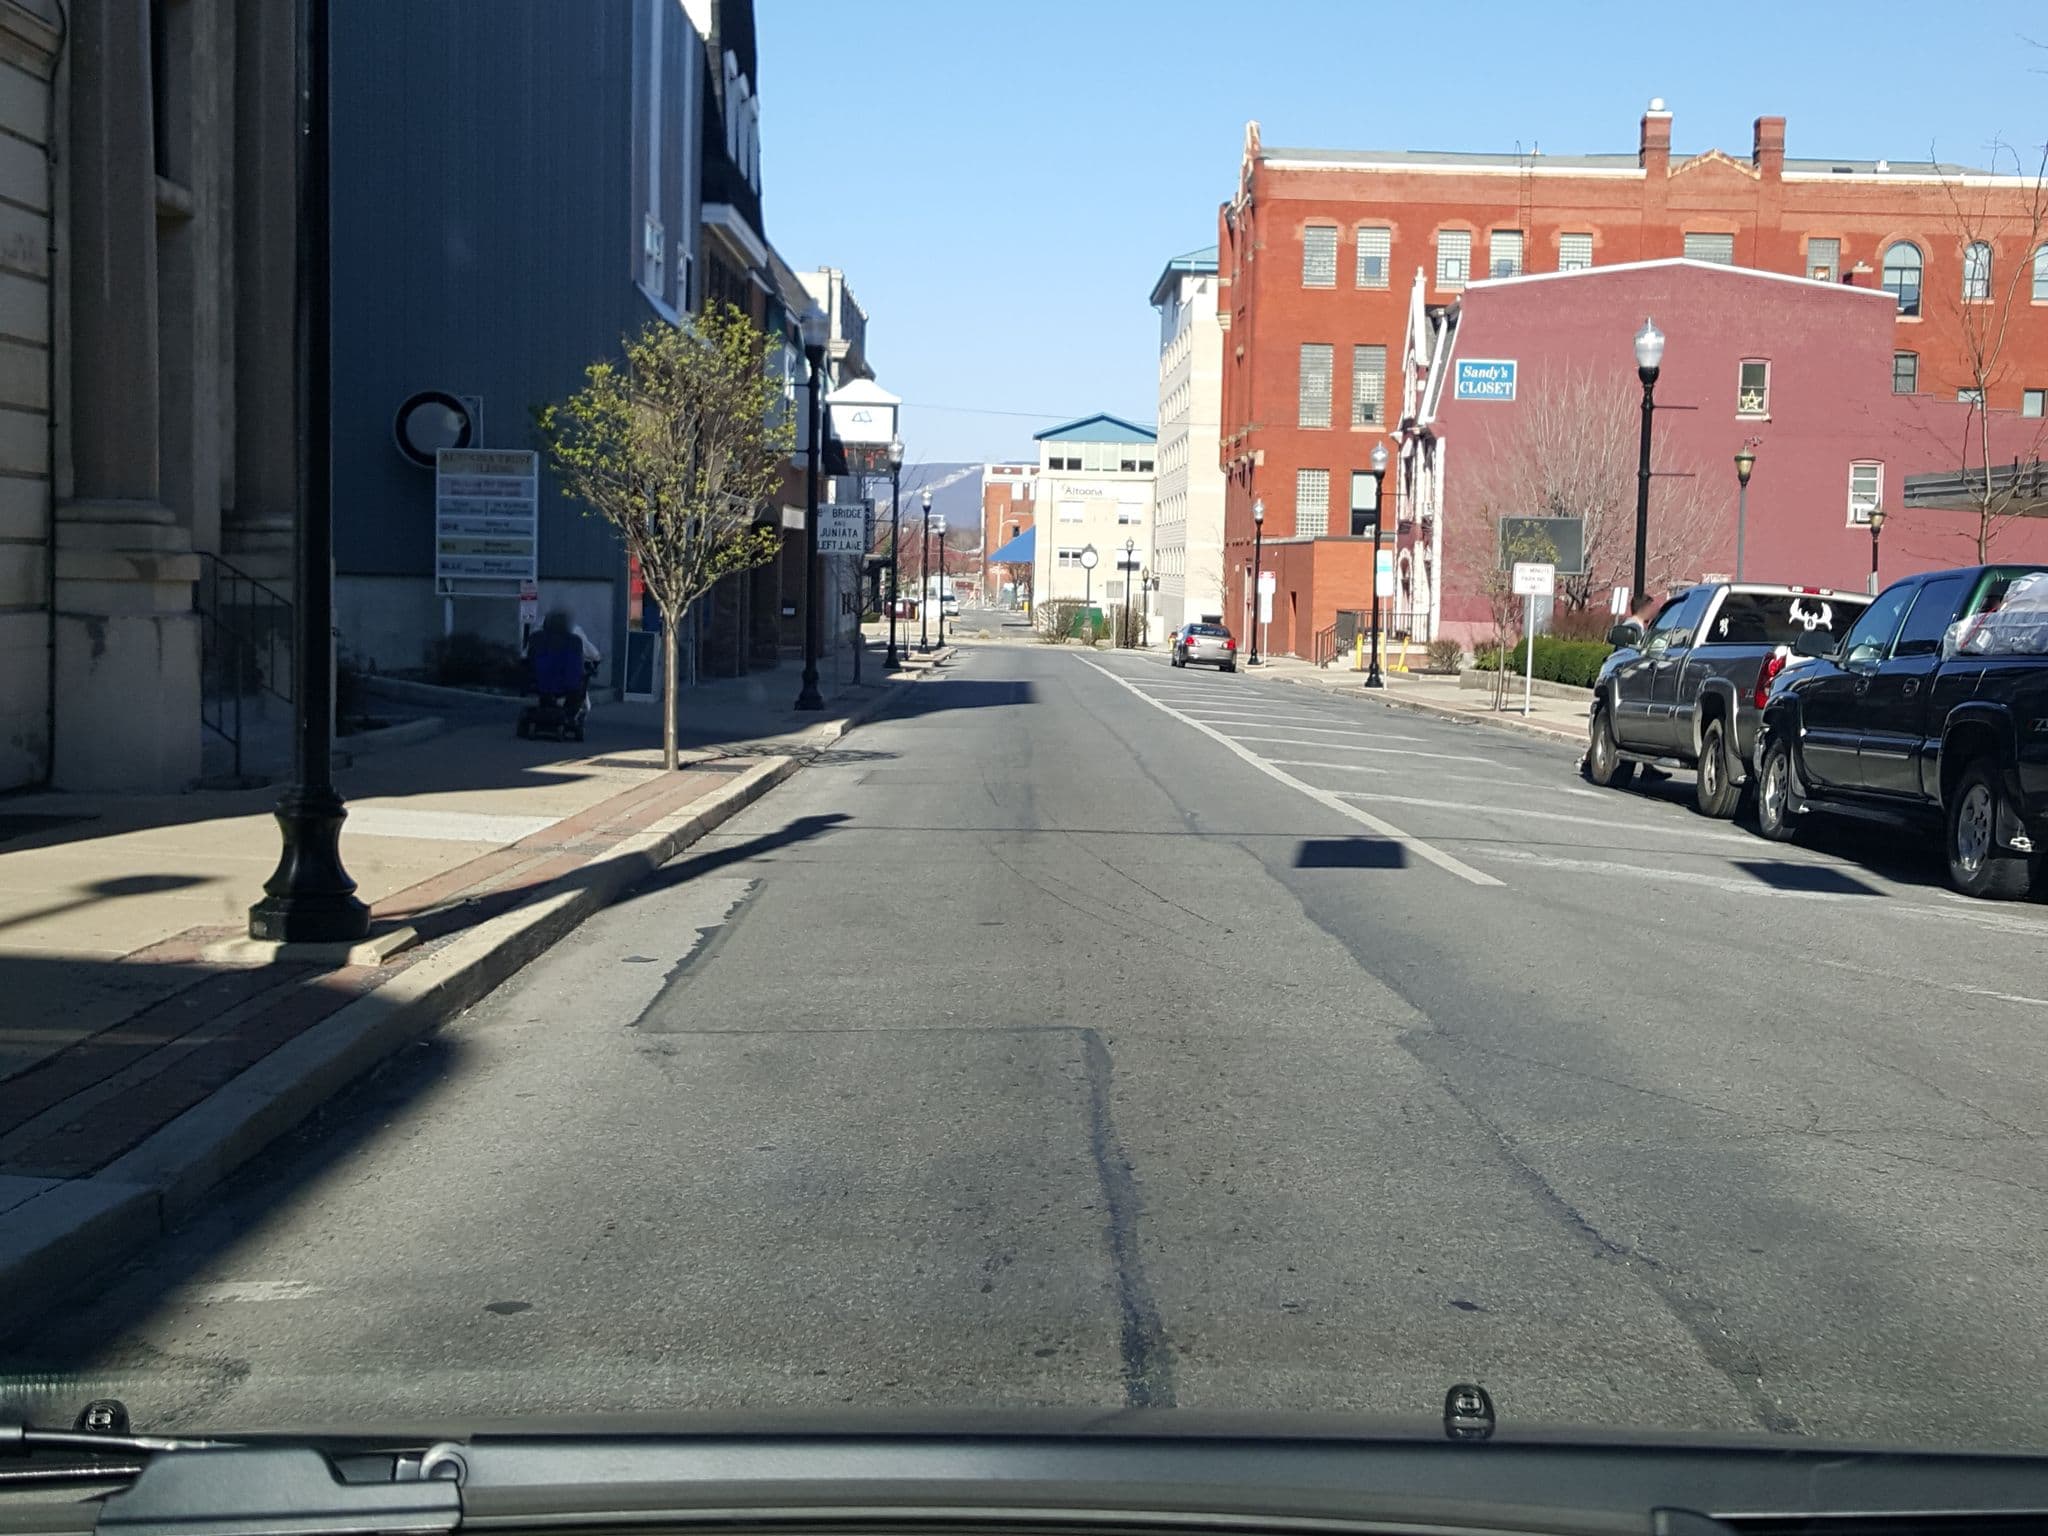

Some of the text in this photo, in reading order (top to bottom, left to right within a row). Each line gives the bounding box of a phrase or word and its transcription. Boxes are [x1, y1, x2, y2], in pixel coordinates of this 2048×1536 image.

[1462, 365, 1508, 381] Sandy's
[1459, 381, 1512, 395] CLOSET
[1065, 486, 1102, 496] Altoona
[832, 508, 862, 519] BRIDGE
[820, 527, 858, 538] JUNIATA
[817, 540, 836, 550] LEFT
